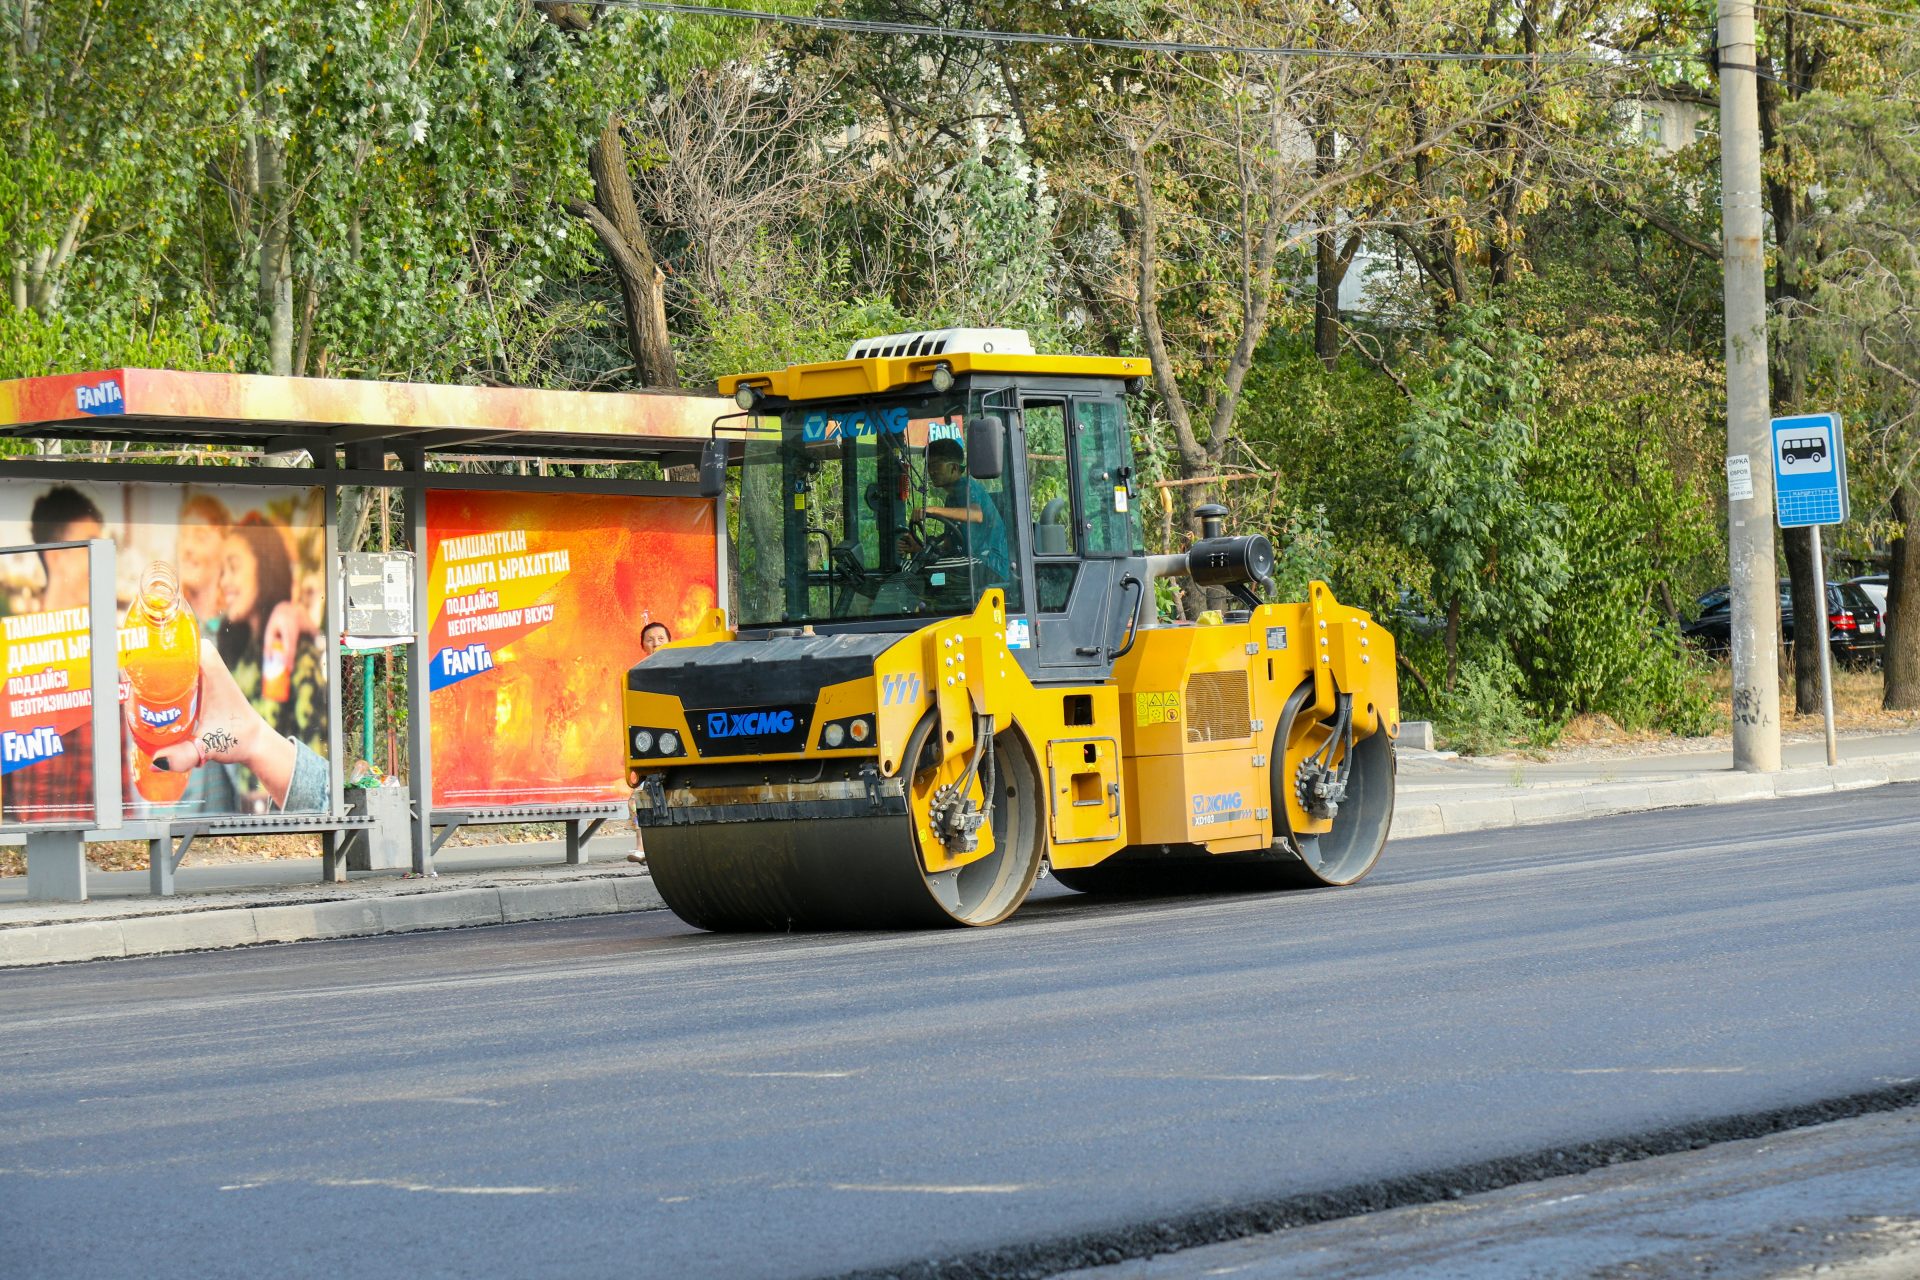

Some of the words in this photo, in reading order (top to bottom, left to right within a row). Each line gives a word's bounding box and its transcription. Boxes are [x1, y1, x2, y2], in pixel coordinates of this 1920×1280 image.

[76, 380, 122, 410] FANTA
[928, 421, 962, 441] FANTA
[440, 529, 527, 562] ТАМШАНТКАН
[445, 561, 497, 595] ДААМГА
[498, 549, 571, 582] ЫРАХАТТАН
[445, 588, 499, 617] ПОДДАЙСЯ
[448, 609, 523, 637] НЕОТРАЗИМОМУ
[524, 604, 555, 625] ВКУСУ
[7, 637, 67, 674] ДААМГА
[442, 643, 494, 676] FANTA
[8, 667, 69, 697] ПОДДАЙСЯ
[138, 704, 182, 723] FANTA
[727, 710, 795, 737] XCMG
[3, 727, 64, 762] FANTA
[1206, 791, 1243, 813] XCMG
[1194, 814, 1215, 827] XD103
